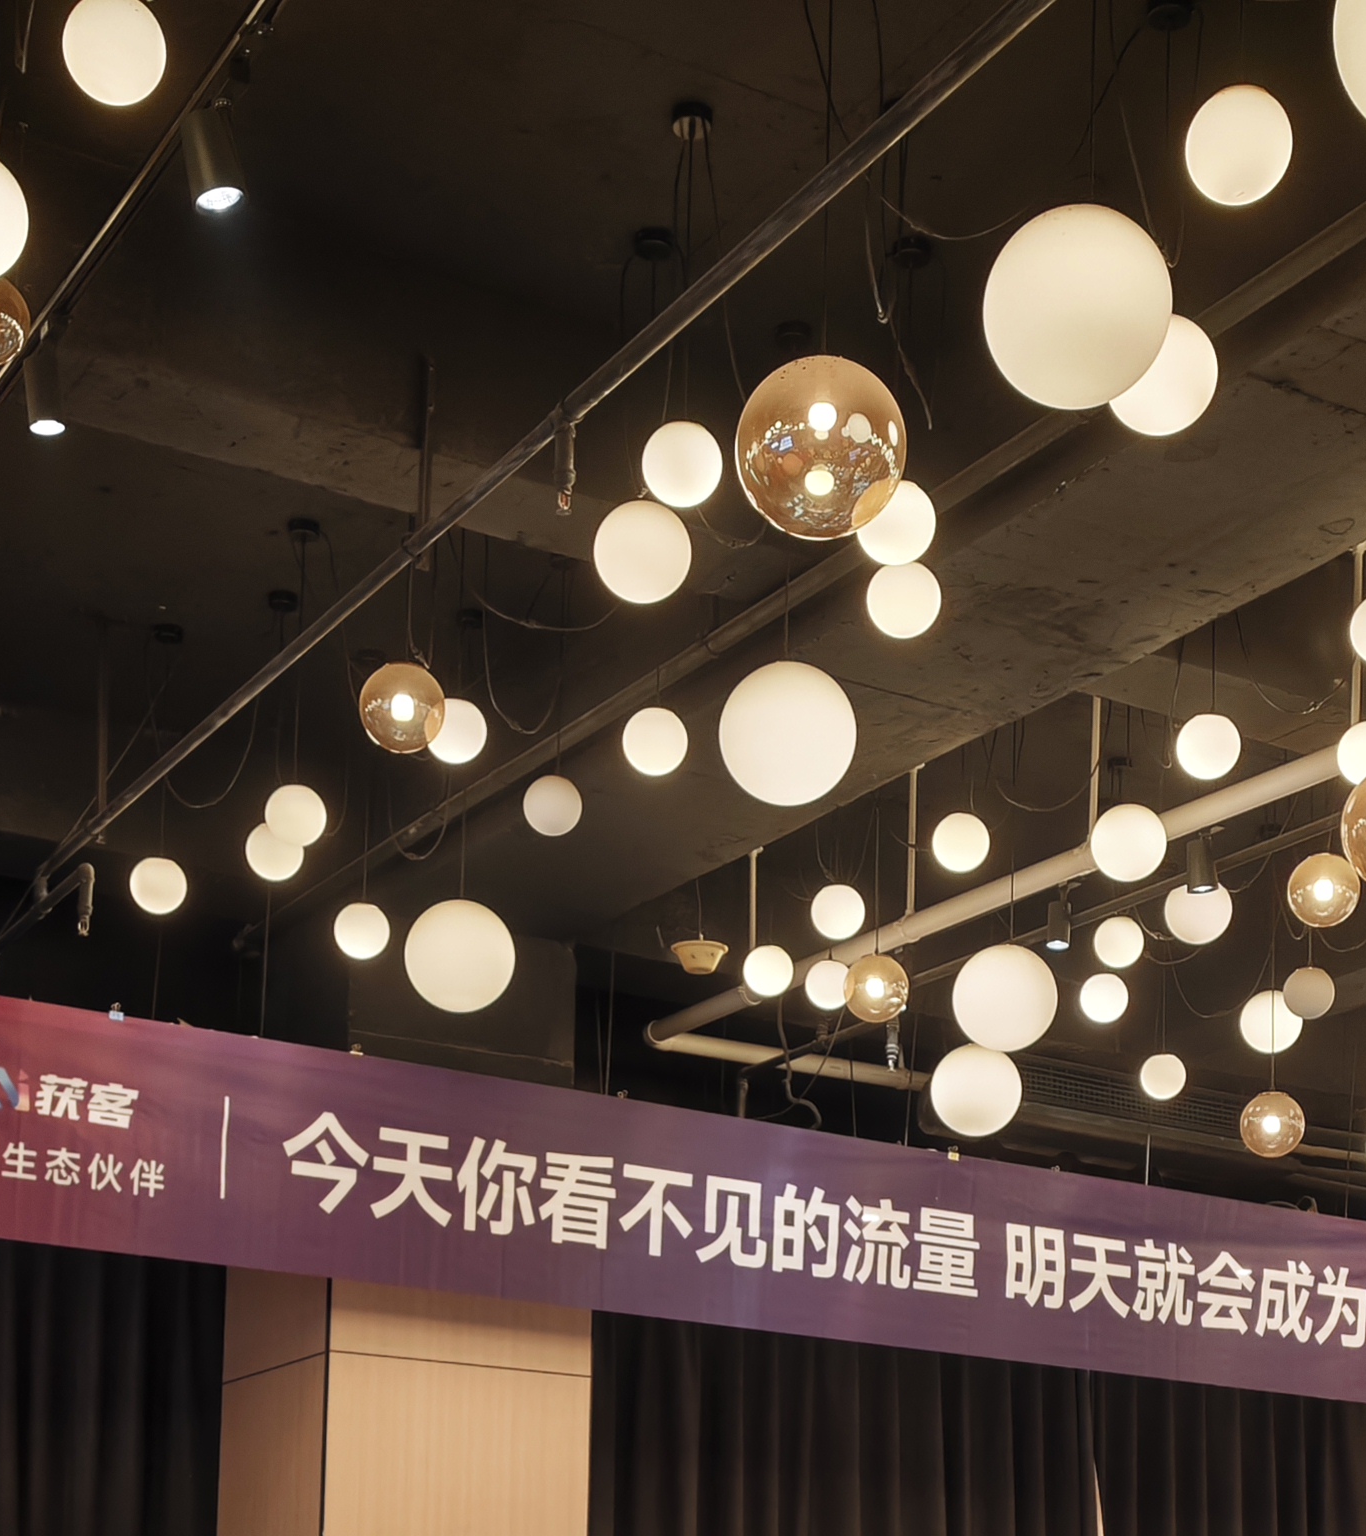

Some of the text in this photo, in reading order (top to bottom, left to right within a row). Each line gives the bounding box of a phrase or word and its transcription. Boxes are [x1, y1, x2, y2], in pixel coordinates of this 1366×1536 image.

[282, 1110, 981, 1299] 今天你看不见的流量
